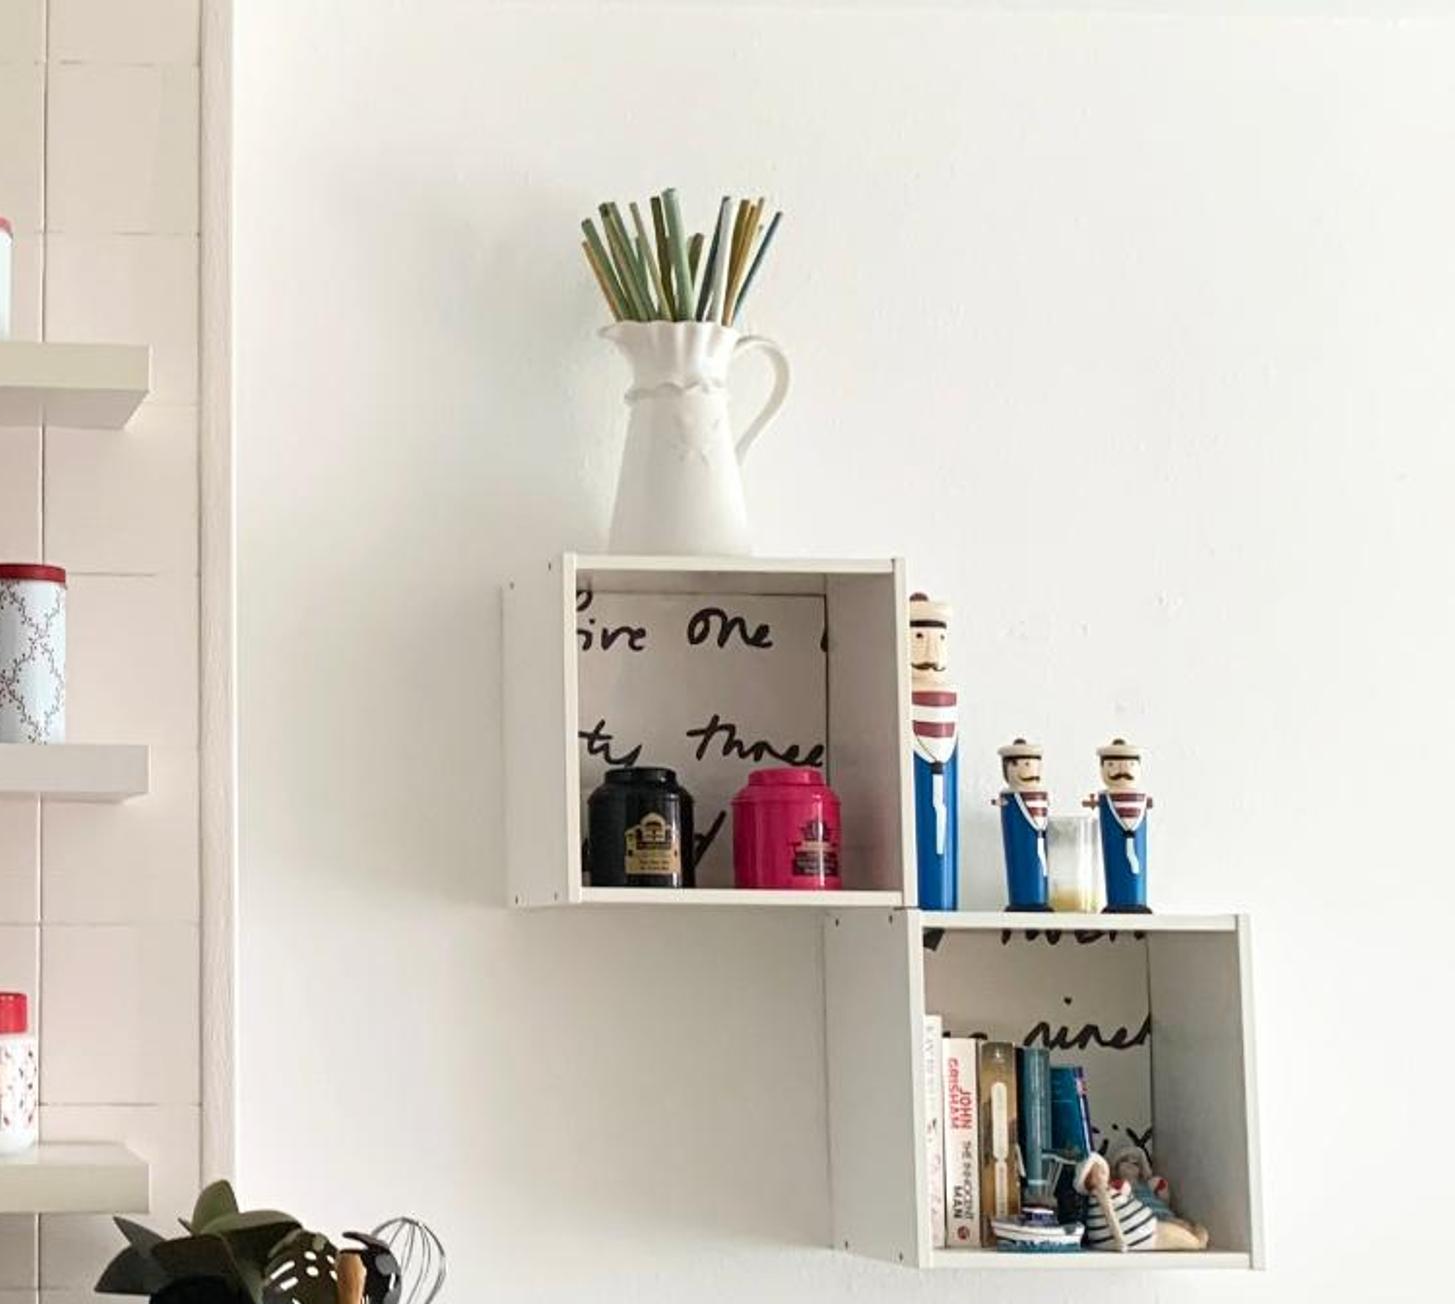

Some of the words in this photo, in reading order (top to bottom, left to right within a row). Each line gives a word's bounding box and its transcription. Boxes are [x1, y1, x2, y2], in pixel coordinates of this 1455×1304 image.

[578, 619, 646, 650] ive
[578, 719, 642, 766] ty
[686, 713, 825, 768] three
[959, 1086, 973, 1130] JOHN
[953, 1185, 964, 1219] MAN
